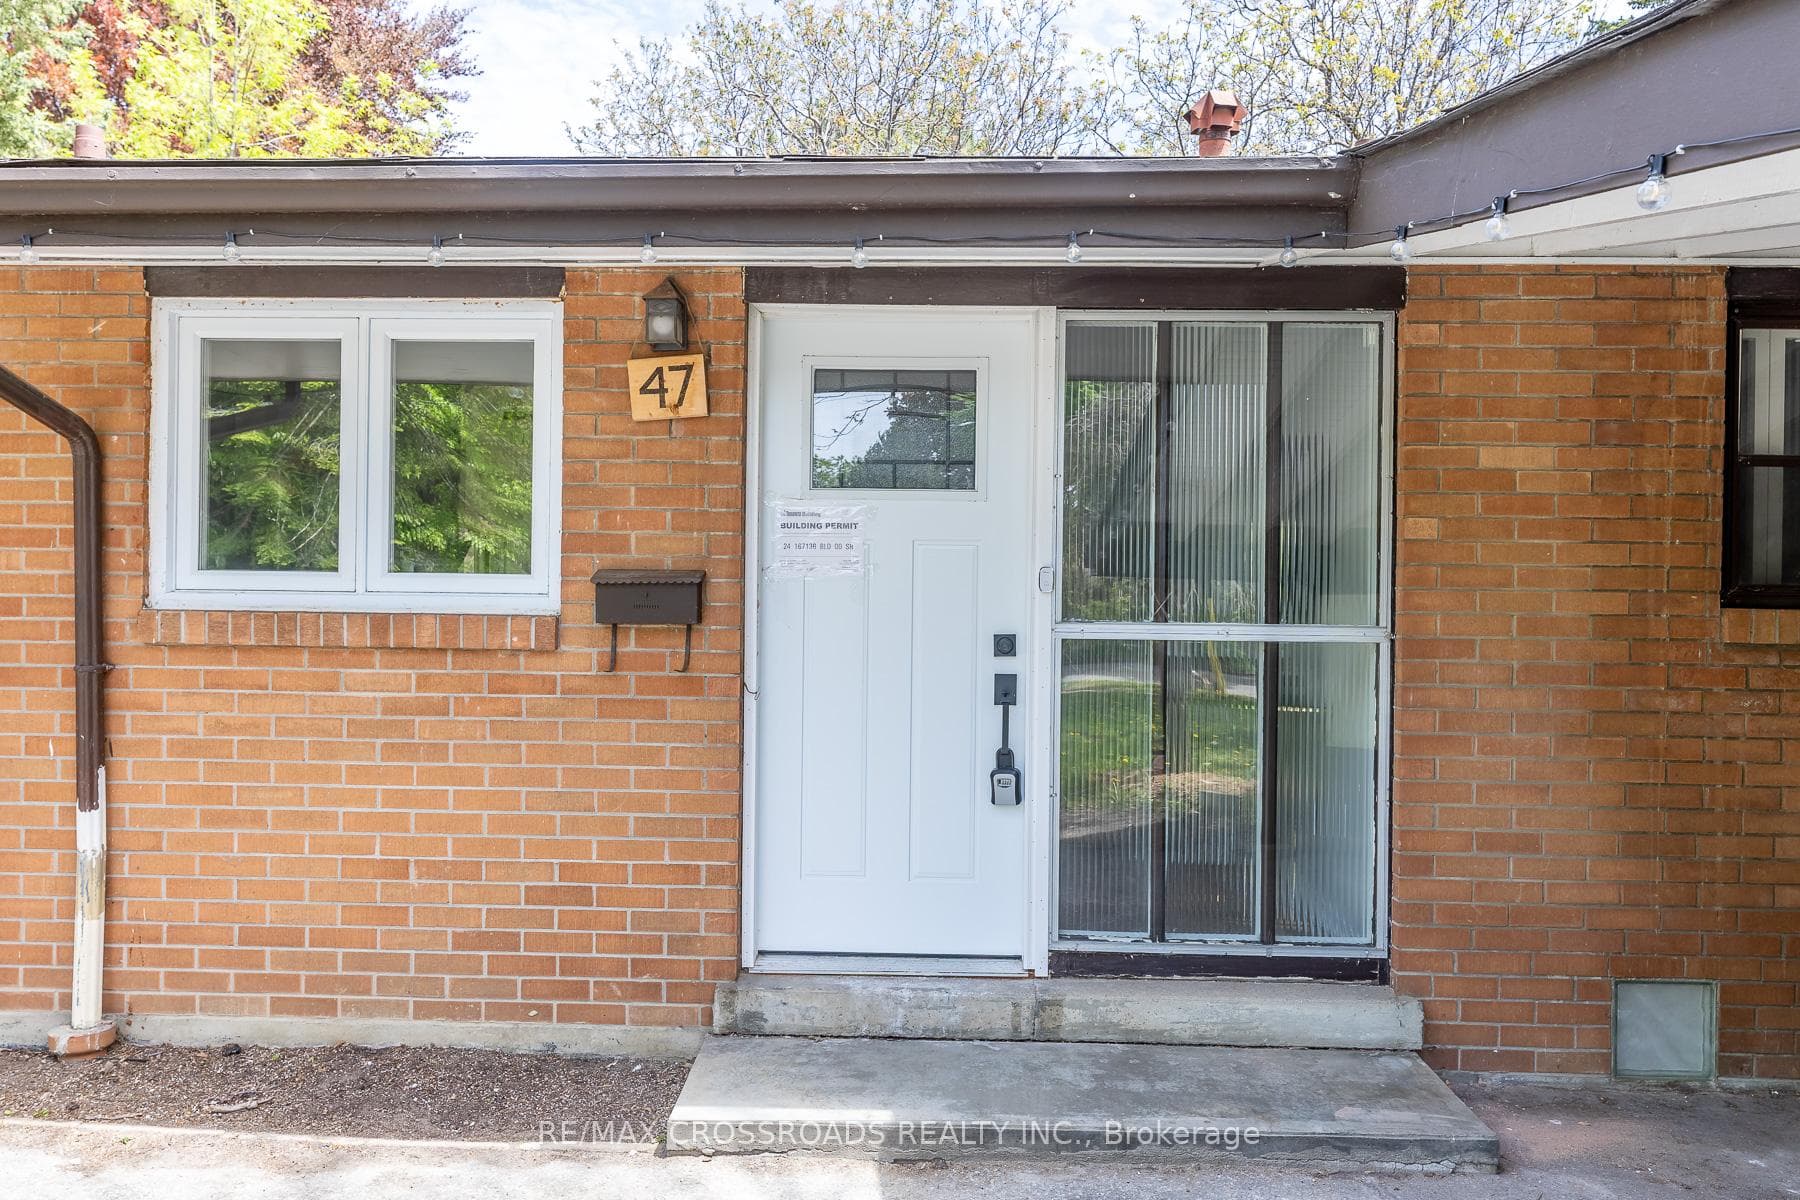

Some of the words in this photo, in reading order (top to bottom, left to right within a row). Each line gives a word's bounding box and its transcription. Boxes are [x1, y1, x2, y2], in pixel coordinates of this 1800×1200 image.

[639, 362, 694, 408] 47
[780, 522, 823, 530] BUILDING
[825, 522, 859, 530] PERMIT
